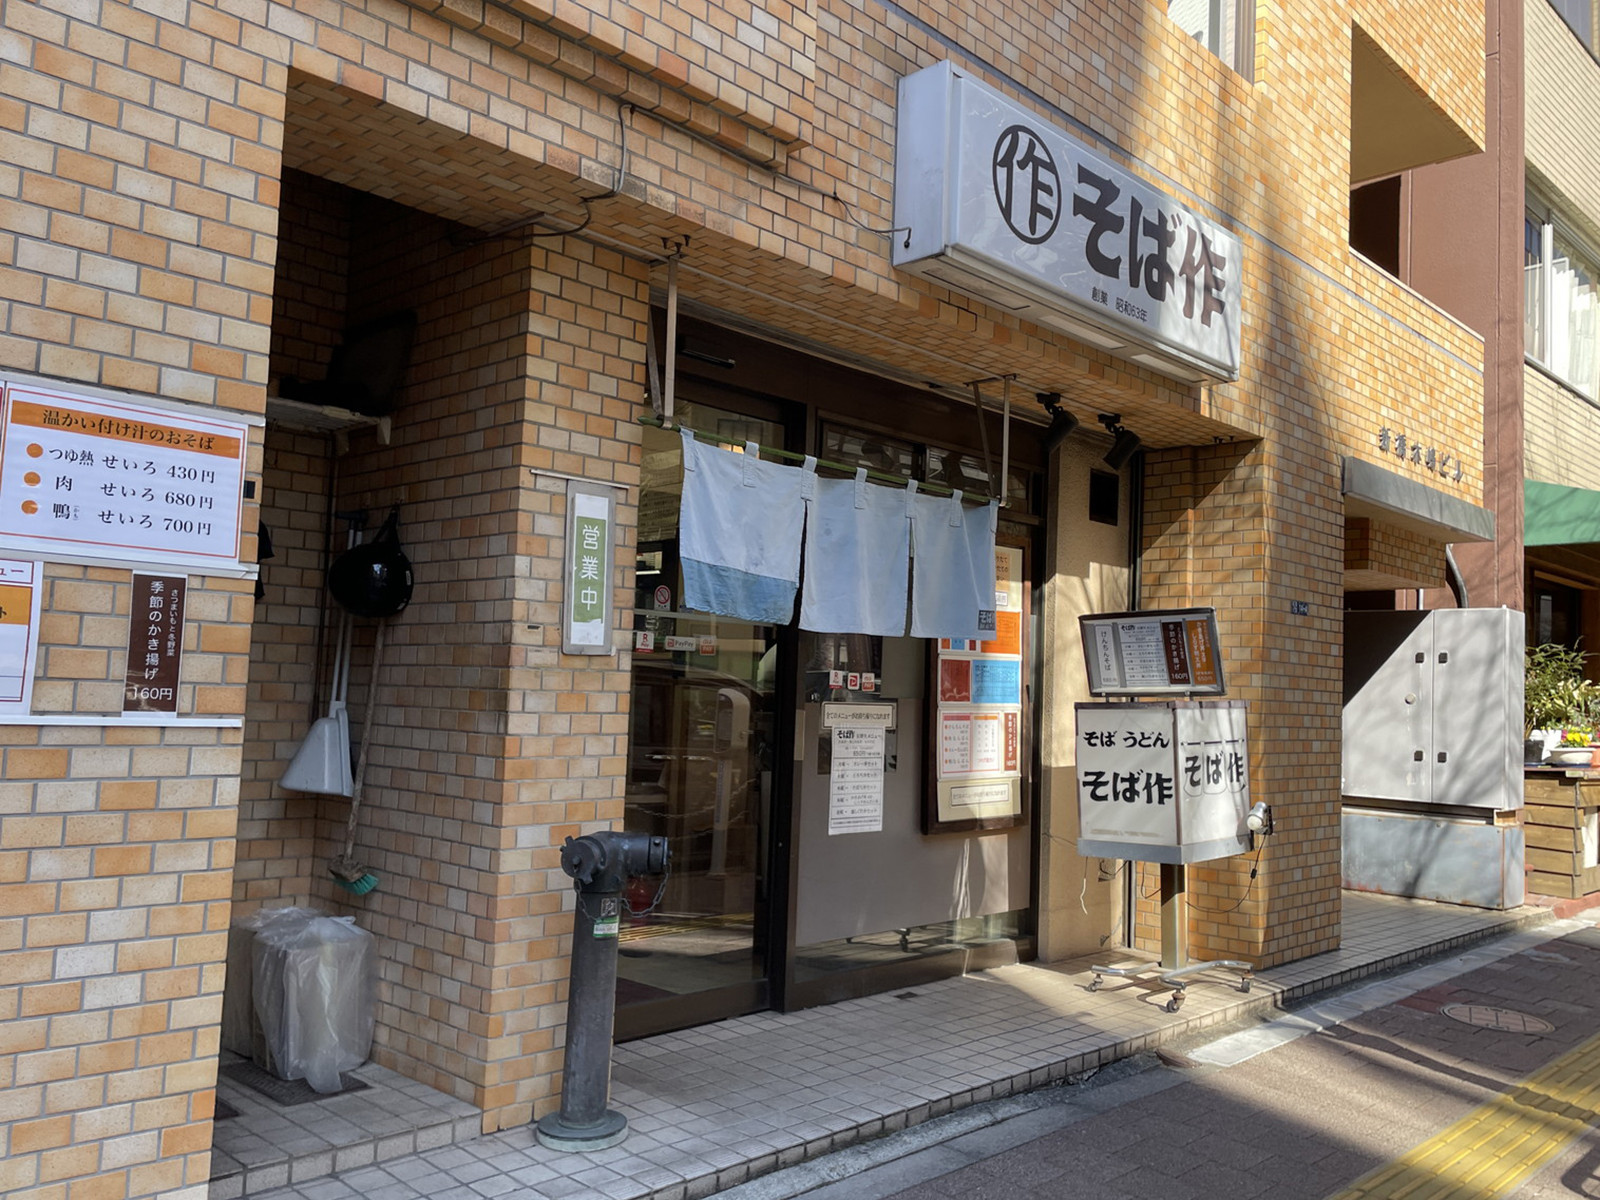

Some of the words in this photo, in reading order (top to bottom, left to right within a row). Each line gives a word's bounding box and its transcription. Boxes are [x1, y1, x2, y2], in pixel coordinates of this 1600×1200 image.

[996, 130, 1056, 237] 作
[1073, 162, 1226, 328] そば作
[1091, 286, 1108, 306] 創業
[1115, 296, 1148, 323] 昭和63年
[42, 409, 216, 450] 温かい付け汁のおそば
[49, 447, 94, 467] つゆ熱
[102, 455, 157, 475] せいろ
[167, 464, 215, 484] 430円
[55, 476, 73, 491] 肉
[100, 482, 155, 502] せいろ
[165, 491, 213, 510] 680円
[53, 502, 70, 520] 鴨
[98, 510, 153, 528] せいろ
[163, 518, 211, 536] 700円
[580, 524, 600, 611] 営業中
[144, 581, 164, 680] 季節のかき揚げ
[675, 640, 694, 648] PayPay
[1100, 631, 1111, 671] けんちんそば
[132, 687, 173, 701] 160円
[1083, 730, 1116, 749] そば
[1122, 731, 1170, 749] うどん
[1082, 769, 1173, 805] そば作
[1184, 751, 1244, 787] そば作
